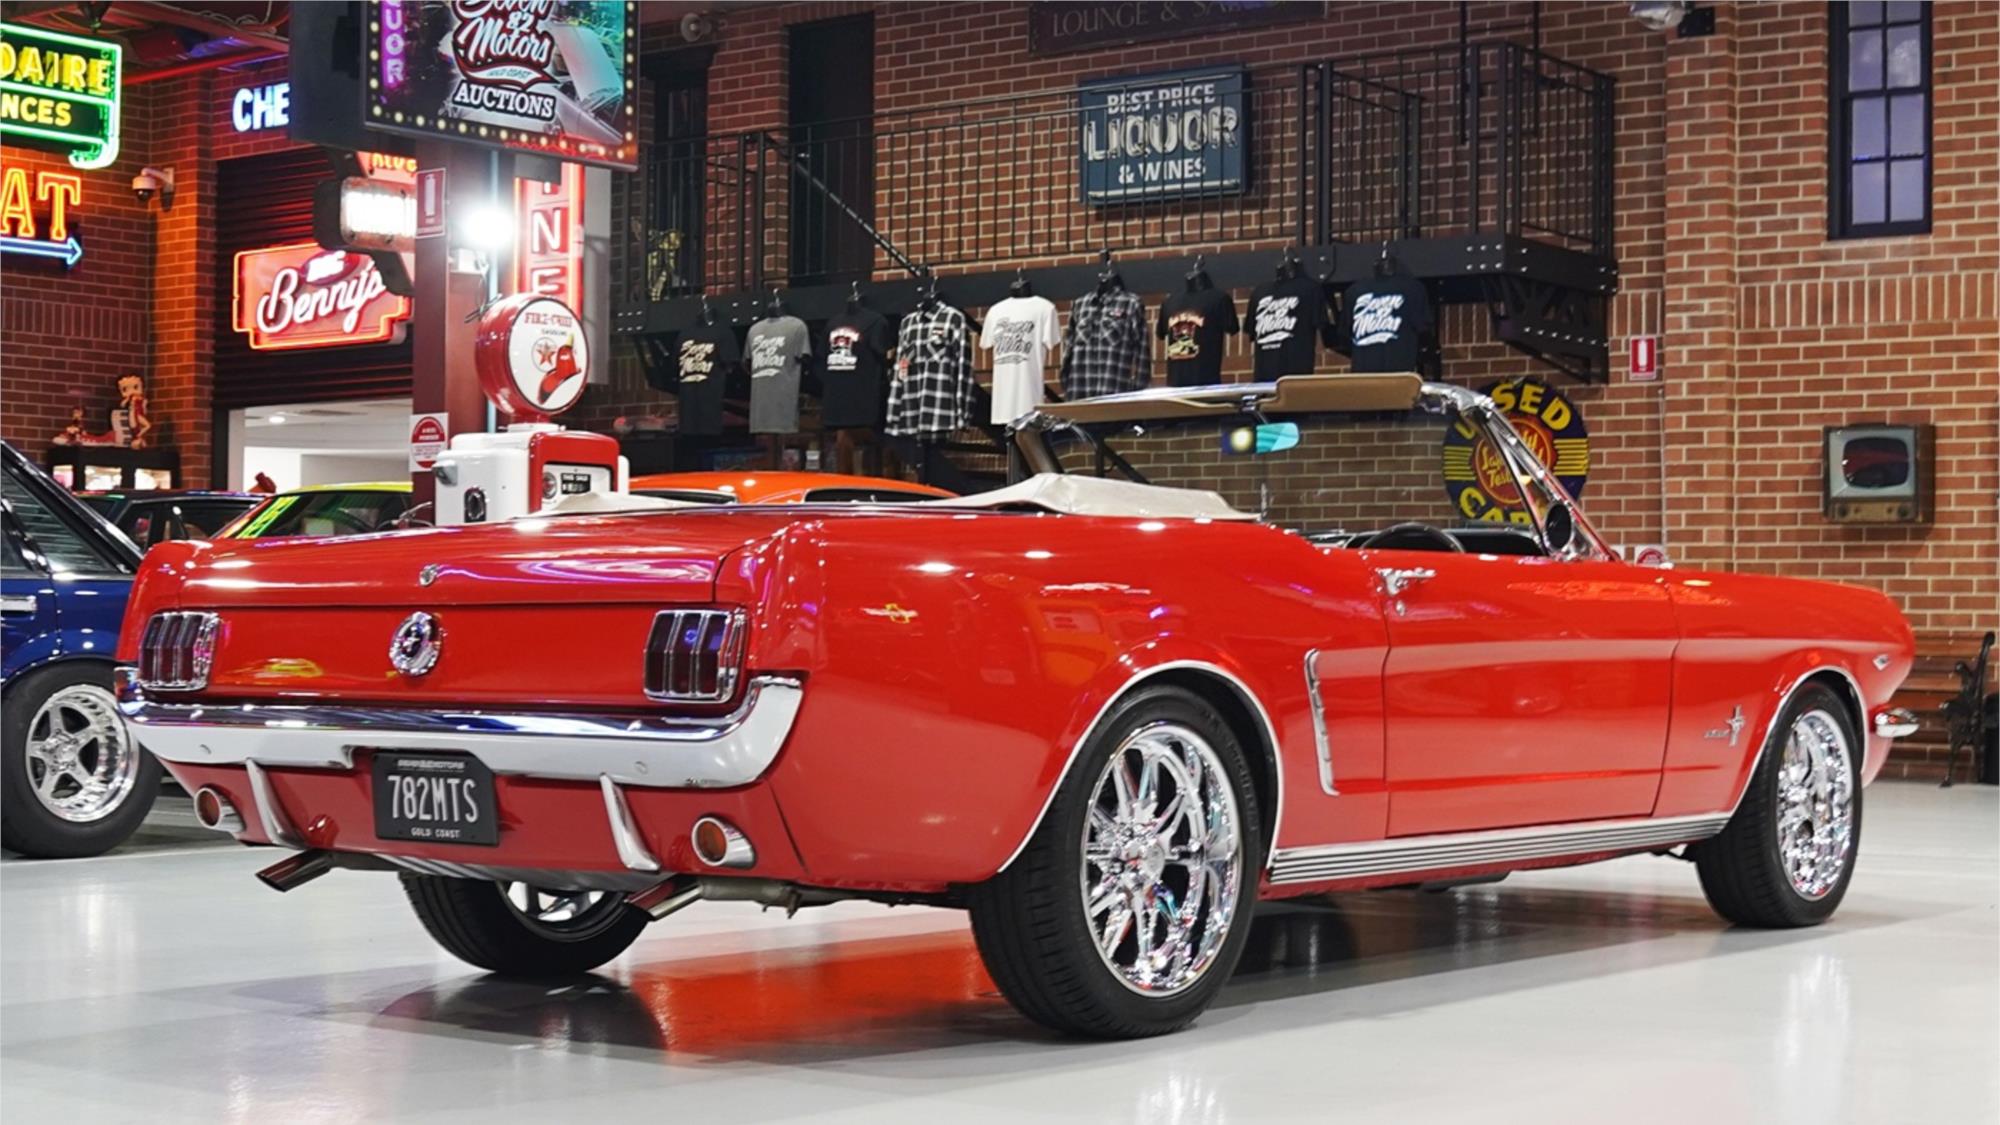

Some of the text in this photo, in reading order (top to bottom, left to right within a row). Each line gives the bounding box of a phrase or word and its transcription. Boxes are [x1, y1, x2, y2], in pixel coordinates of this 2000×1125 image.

[507, 11, 534, 32] 82
[1053, 3, 1148, 37] LOUNGE
[1160, 2, 1179, 21] &
[458, 17, 551, 62] Motors
[233, 83, 289, 132] CHE
[454, 82, 554, 118] AUCTIONS
[1107, 83, 1215, 114] BEST PRICE
[1084, 106, 1238, 161] LIQUOR
[1119, 157, 1206, 184] & WINES
[387, 775, 479, 823] 782MTS
[411, 827, 461, 839] GOLD COAST
